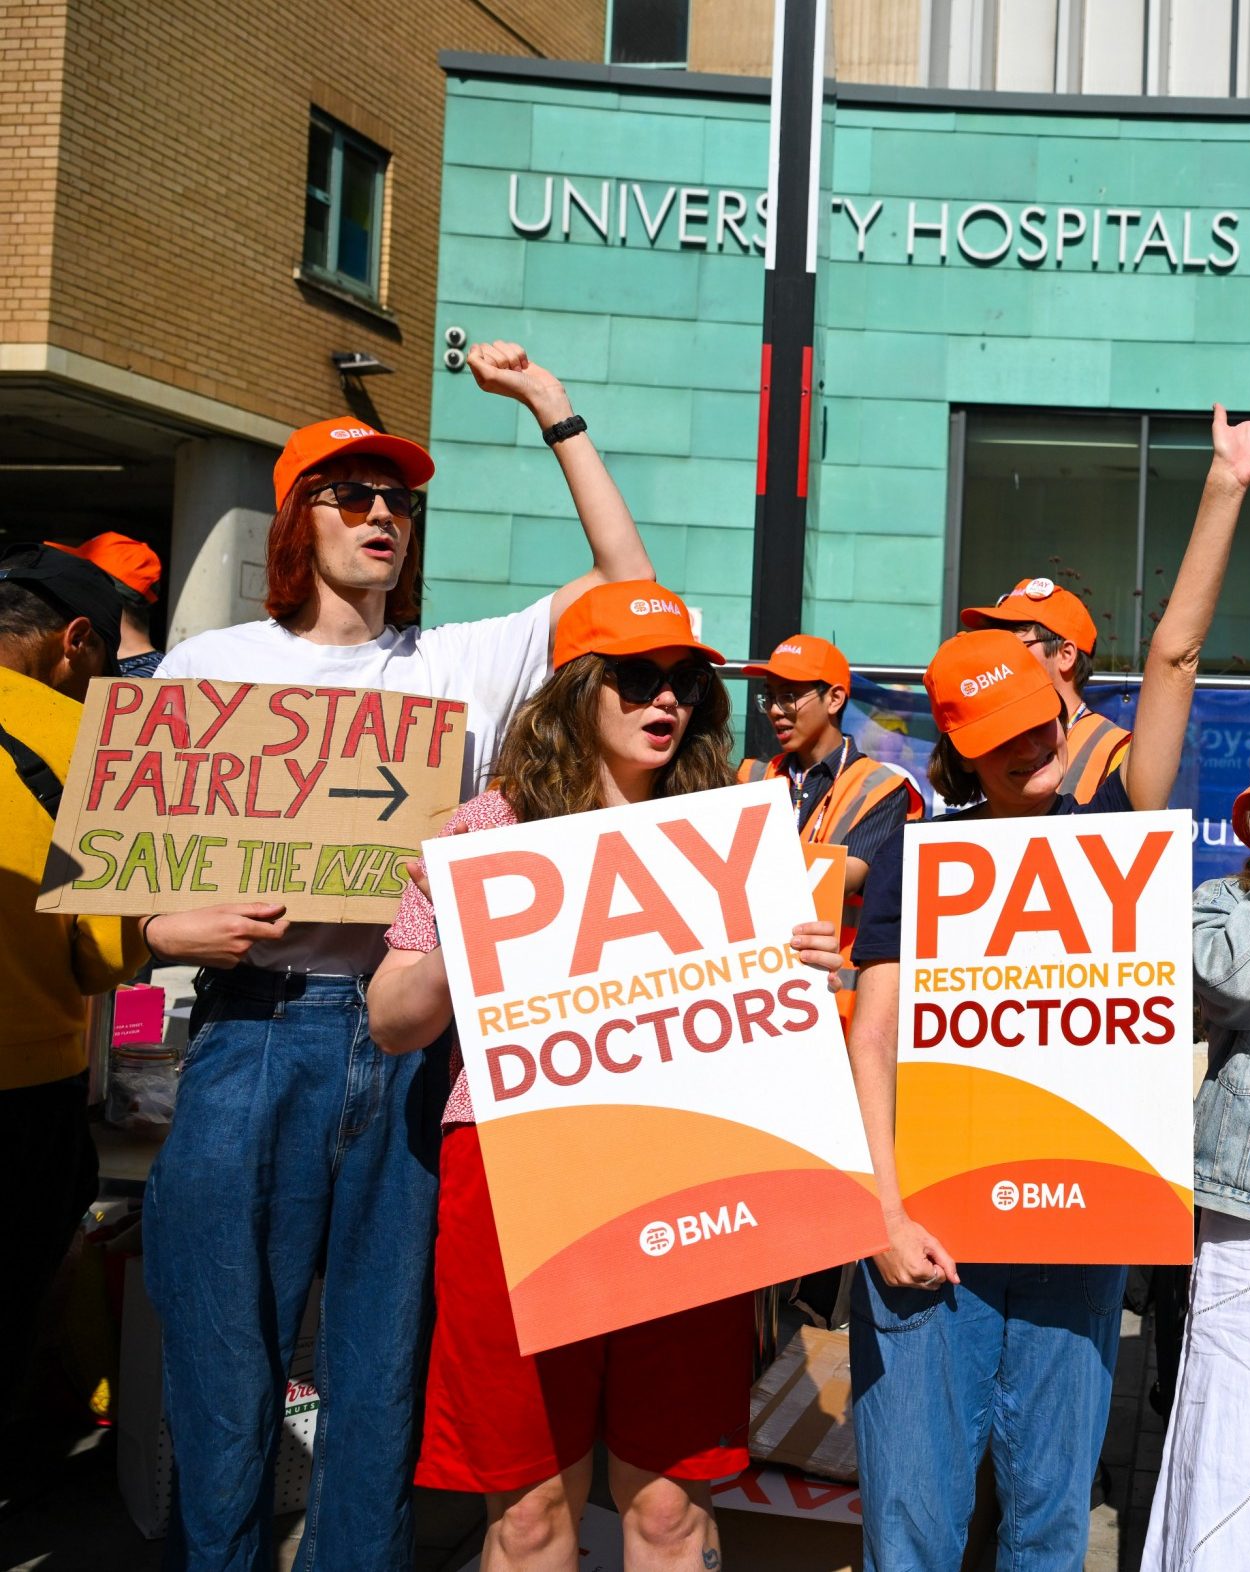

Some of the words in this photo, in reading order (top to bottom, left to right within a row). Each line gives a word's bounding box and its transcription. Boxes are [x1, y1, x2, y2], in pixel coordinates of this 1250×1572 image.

[508, 173, 883, 254] UNIVERSY
[906, 201, 1240, 268] HOSPITALS
[650, 599, 681, 616] BMA
[975, 663, 1014, 689] BMA
[99, 680, 256, 749] PAY
[262, 688, 465, 768] STAFF
[86, 750, 328, 818] FAIRLY
[72, 829, 227, 893] SAVE
[238, 840, 312, 893] THE
[316, 849, 418, 894] NHS
[448, 802, 772, 998] PAY
[915, 830, 1174, 960] PAY
[478, 956, 732, 1037] RESTORATION
[741, 944, 803, 979] FOR
[914, 963, 1109, 993] RESTORATION
[1117, 961, 1176, 987] FOR
[484, 979, 819, 1102] DOCTORS
[913, 996, 1176, 1049] DOCTORS
[677, 1201, 758, 1247] BMA
[1022, 1183, 1086, 1209] BMA
